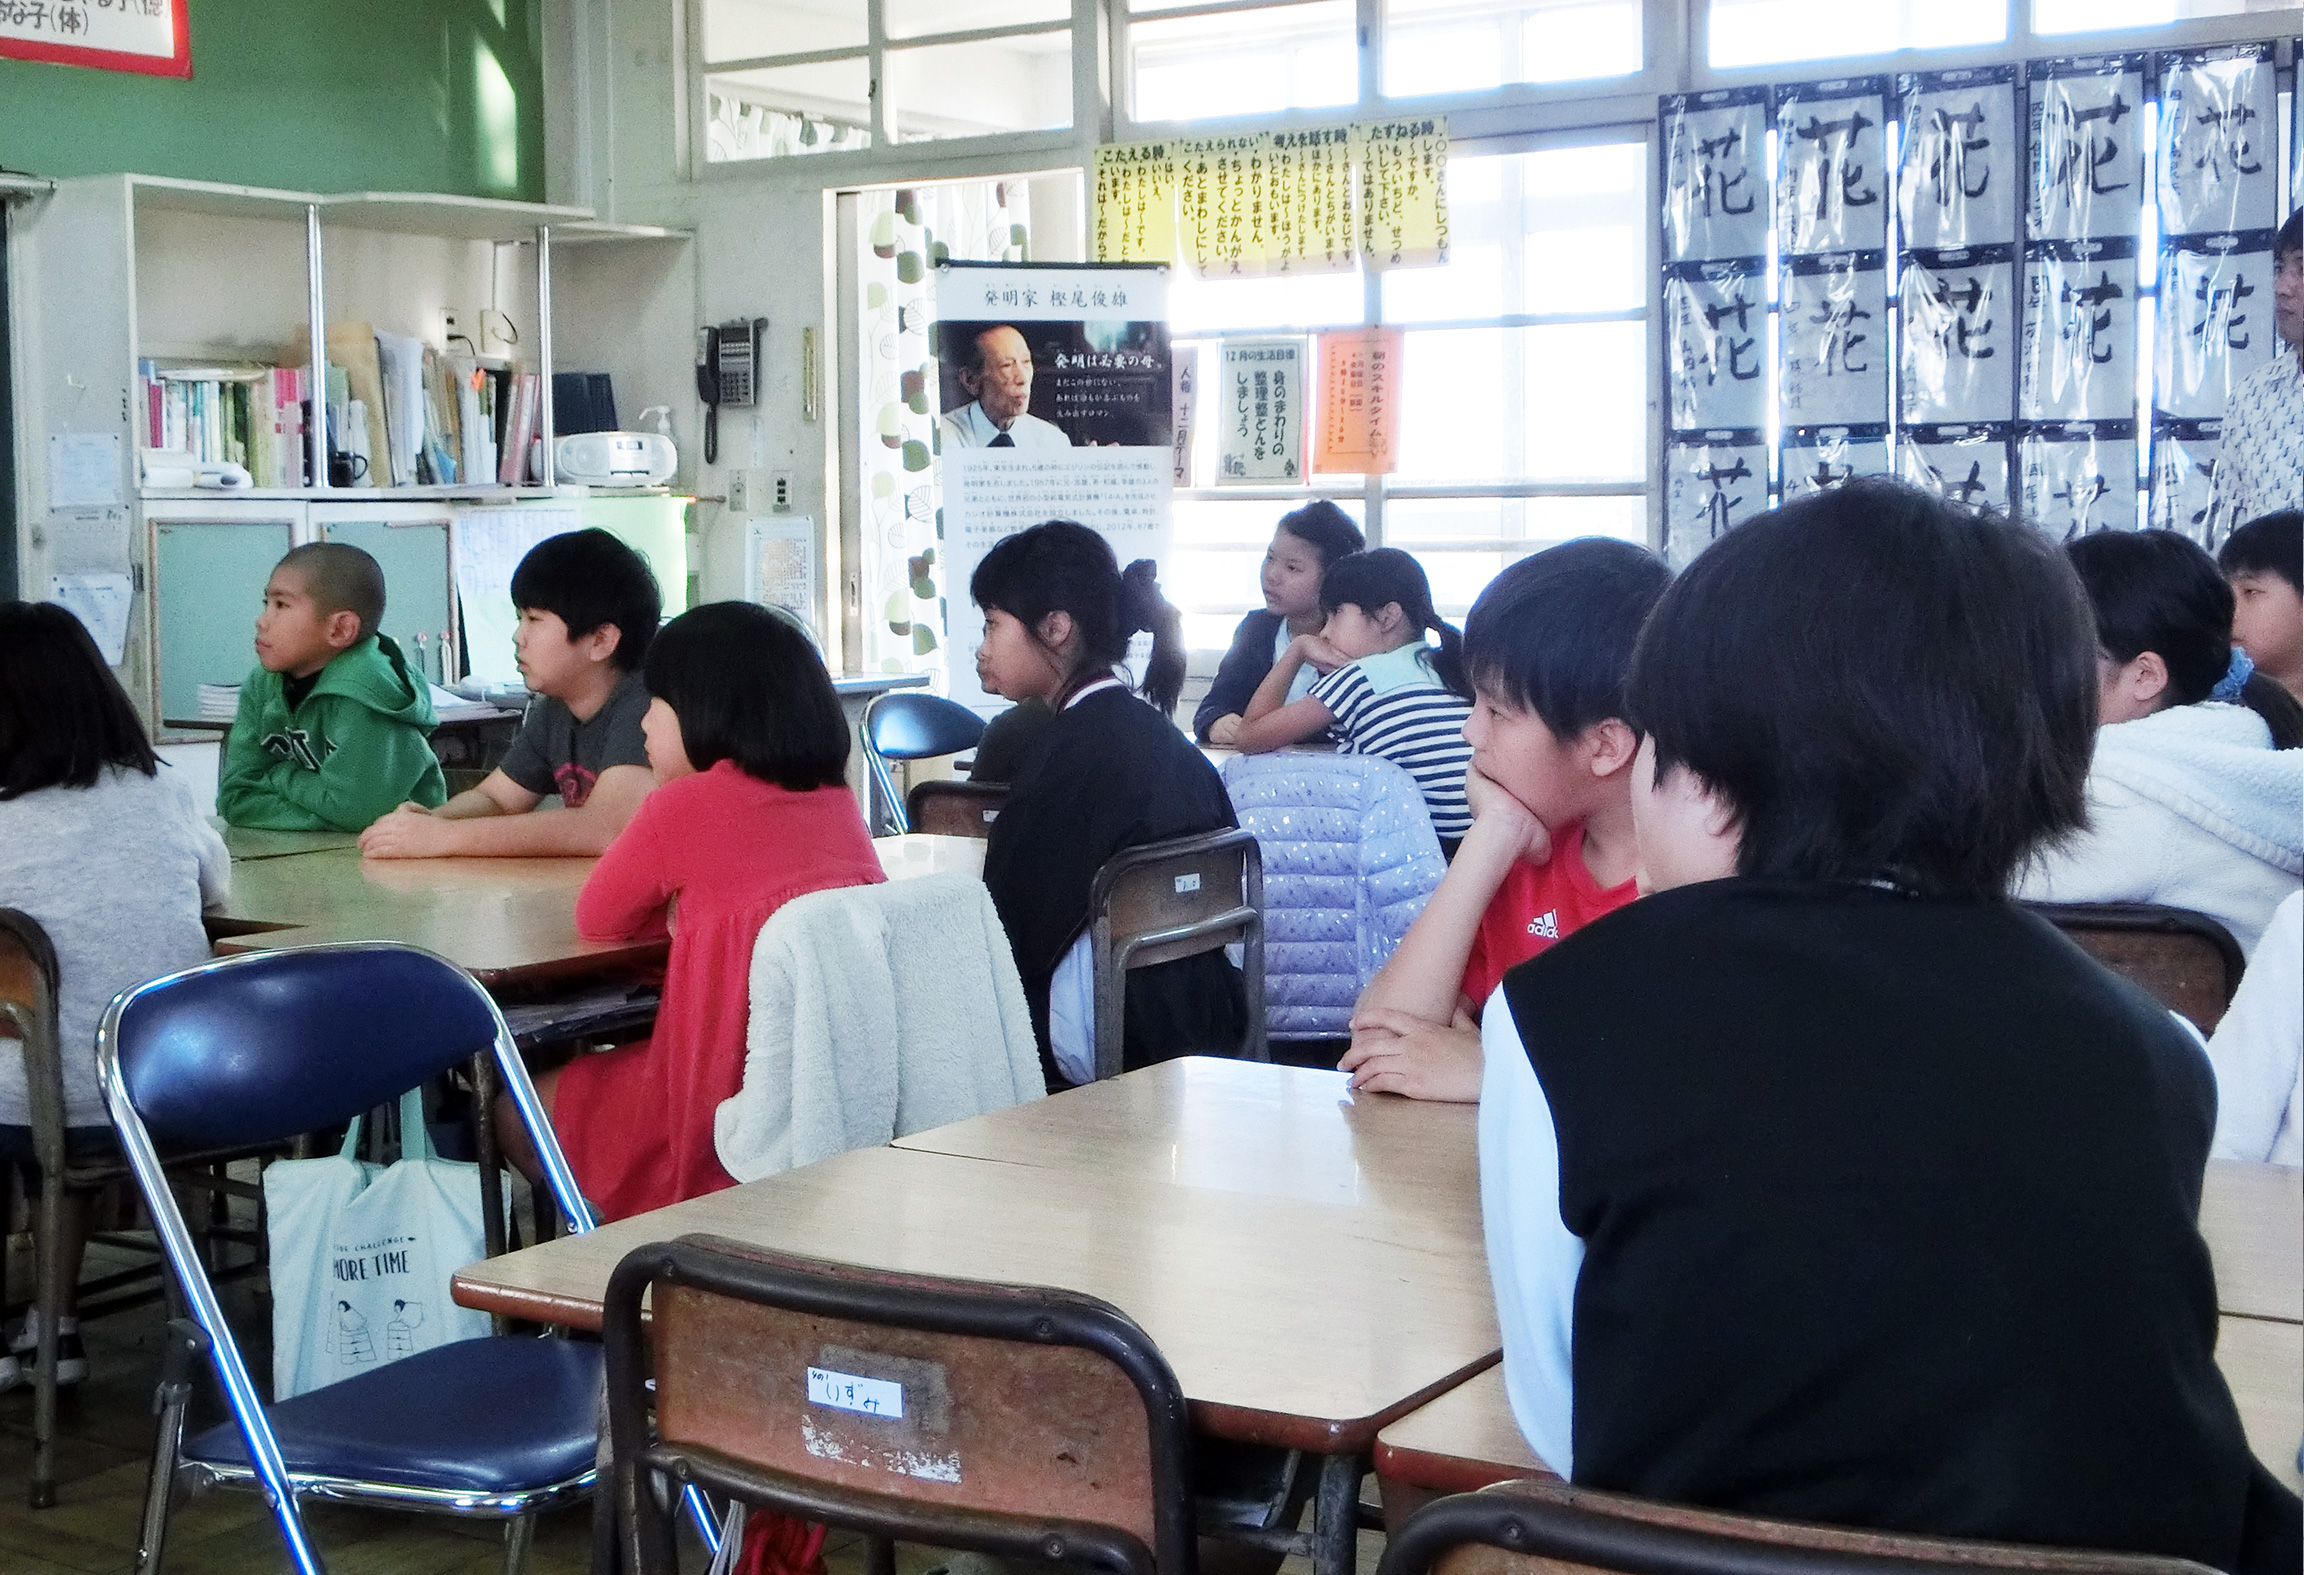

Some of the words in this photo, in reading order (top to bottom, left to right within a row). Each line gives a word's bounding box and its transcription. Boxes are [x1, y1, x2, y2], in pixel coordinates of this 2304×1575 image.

[1184, 137, 1259, 153] こたえられない
[985, 289, 1038, 308] 発明家
[1050, 289, 1128, 308] 樫尾俊雄
[1237, 371, 1249, 438] しましょう
[1272, 370, 1286, 456] 身のまわりの
[1527, 923, 1559, 939] adid
[372, 1250, 410, 1276] TIME
